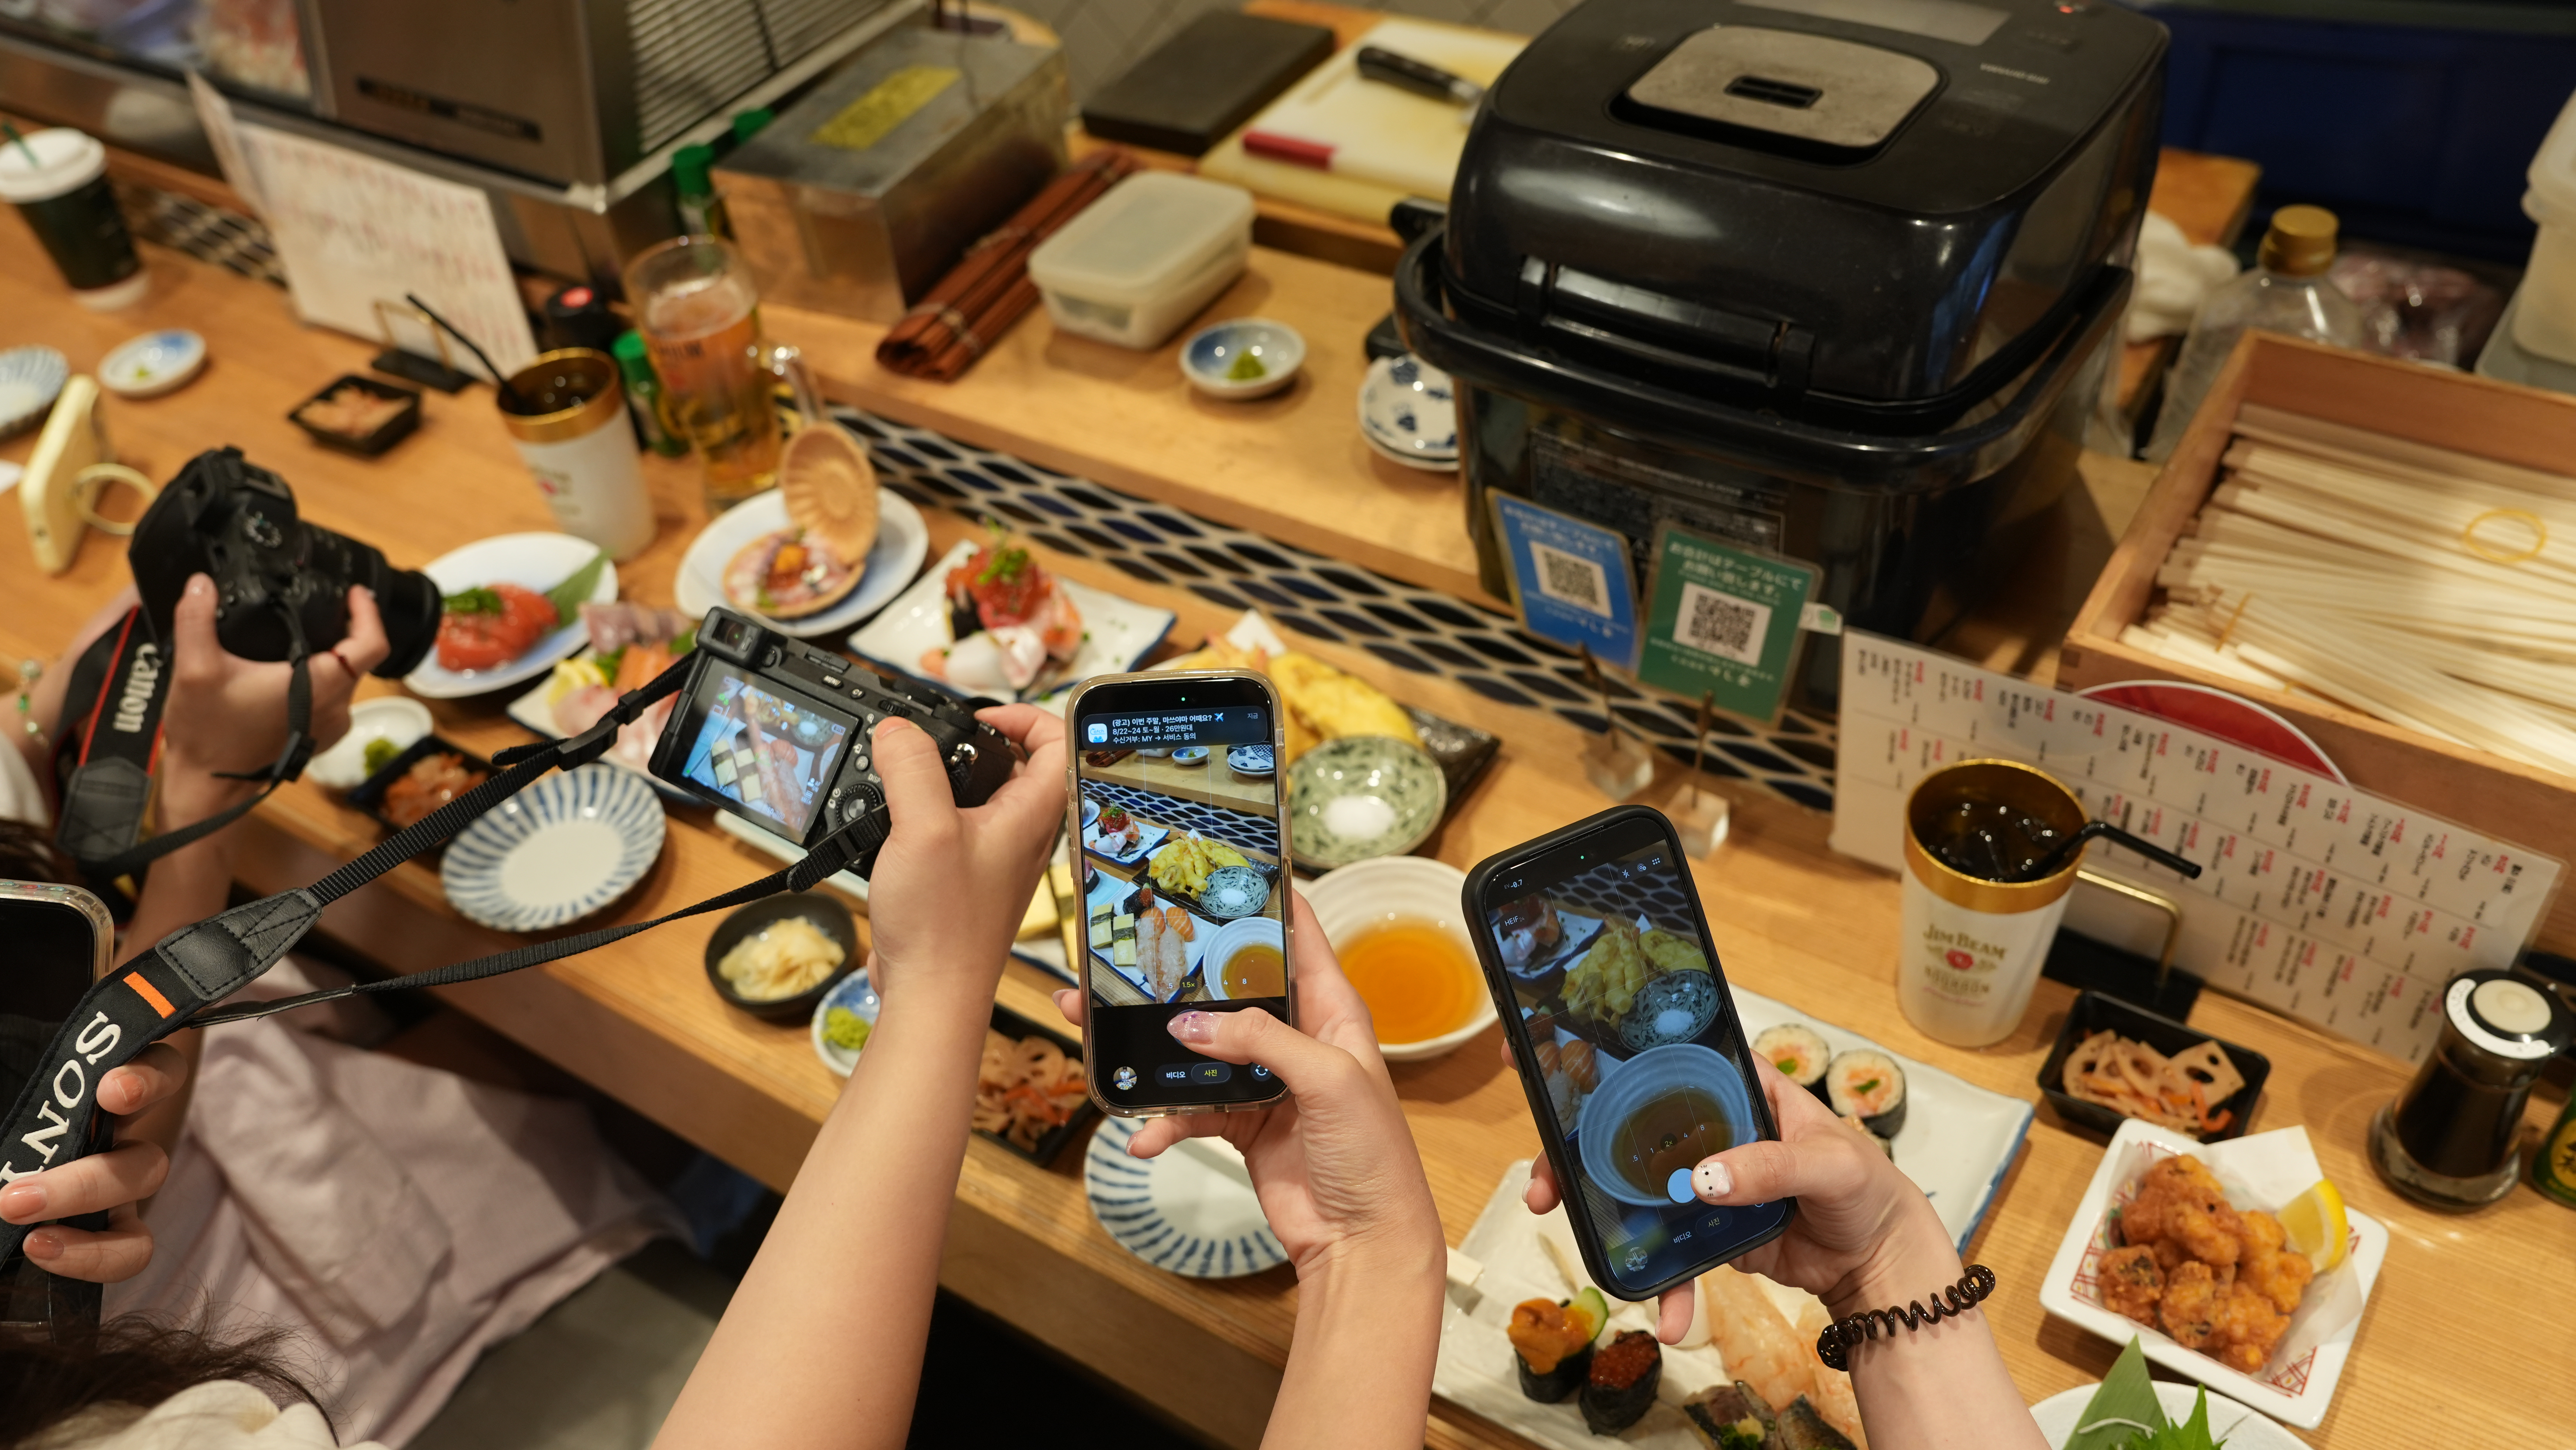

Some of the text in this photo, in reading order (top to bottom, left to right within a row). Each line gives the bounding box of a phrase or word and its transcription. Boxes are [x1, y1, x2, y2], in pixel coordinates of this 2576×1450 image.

[823, 675, 841, 686] MENU
[112, 643, 163, 733] Canon
[1112, 719, 1130, 728] (광고)
[1163, 715, 1188, 724] 마쓰야마
[1112, 727, 1141, 735] 8/22~24
[1165, 724, 1193, 732] 26만원대
[1113, 736, 1140, 744] 수신거부:
[857, 759, 865, 767] Fn
[867, 773, 881, 783] DISP
[1510, 879, 1523, 889] -0.7
[1505, 915, 1519, 926] HEIF
[1957, 932, 2006, 960] BEAM
[1166, 1069, 1217, 1079] 비디오 사진
[1673, 1217, 1720, 1244] 비디오 사진
